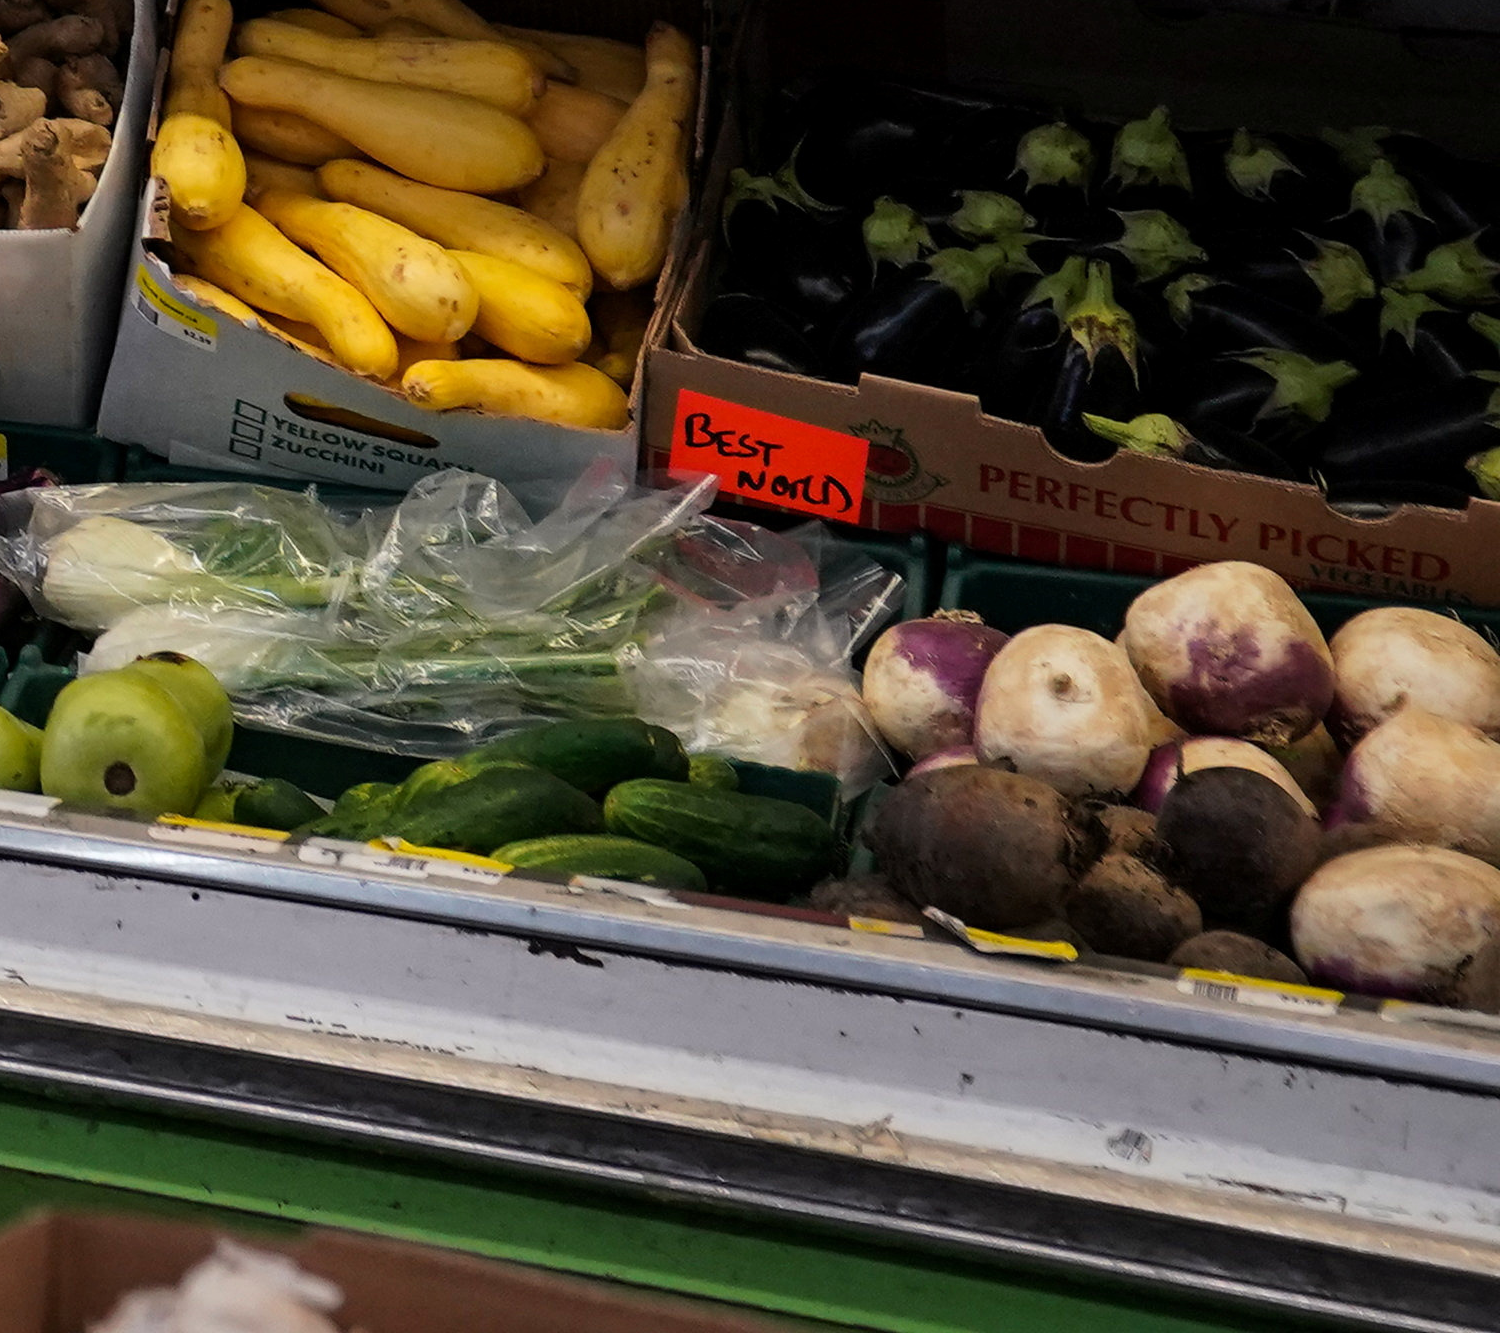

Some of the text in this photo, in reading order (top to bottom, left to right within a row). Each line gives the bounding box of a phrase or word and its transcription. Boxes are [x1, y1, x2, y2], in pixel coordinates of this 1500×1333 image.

[270, 413, 369, 455] YELLOW
[270, 433, 385, 475] ZUCCHINI
[684, 411, 785, 467] BEST
[979, 463, 1450, 583] PERFECTLY PICKED
[1308, 561, 1473, 607] VEGETABLES
